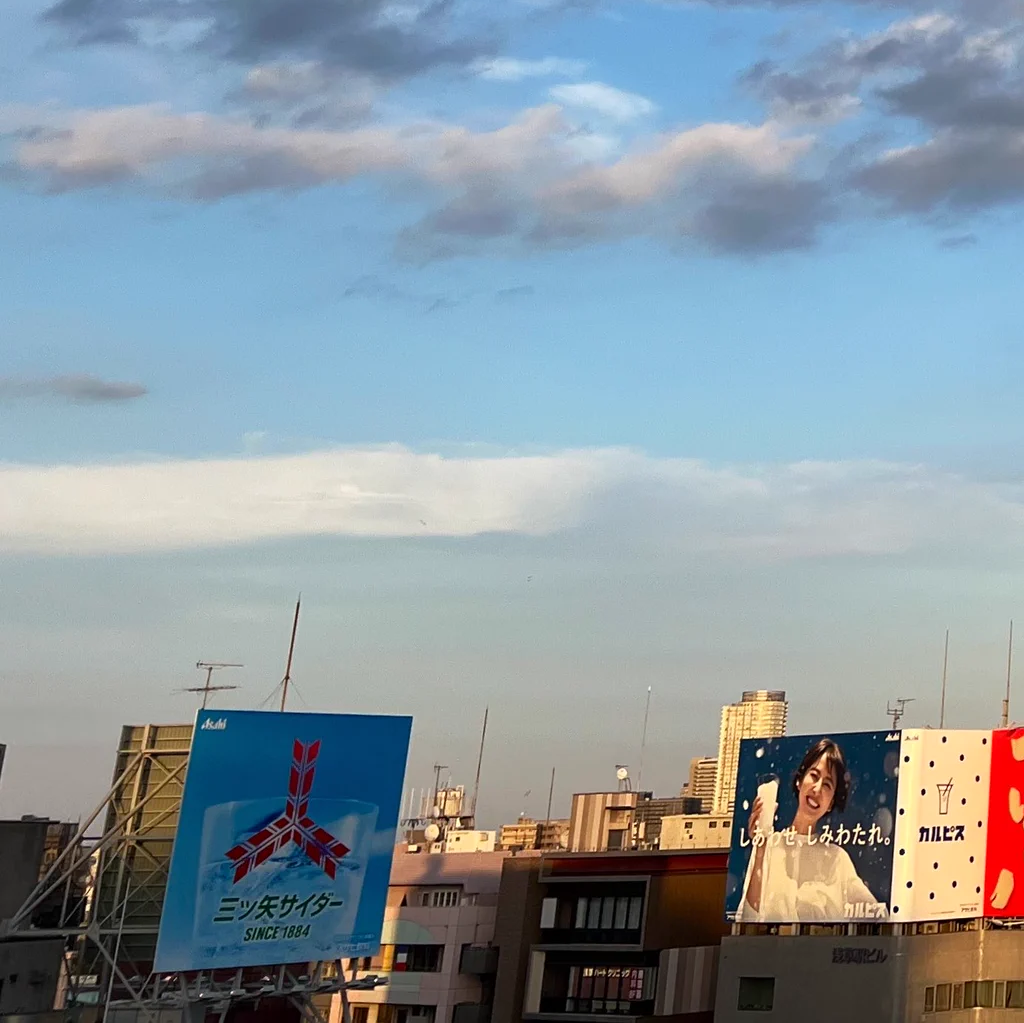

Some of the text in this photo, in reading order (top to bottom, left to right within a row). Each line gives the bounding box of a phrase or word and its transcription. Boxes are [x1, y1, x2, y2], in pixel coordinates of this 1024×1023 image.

[739, 823, 891, 847] しあわせ、しみわたれ。
[919, 825, 965, 842] カルピス
[213, 891, 344, 922] 三ツ矢サイダー
[844, 902, 888, 918] カルピス
[243, 924, 312, 942] SINCE 1884
